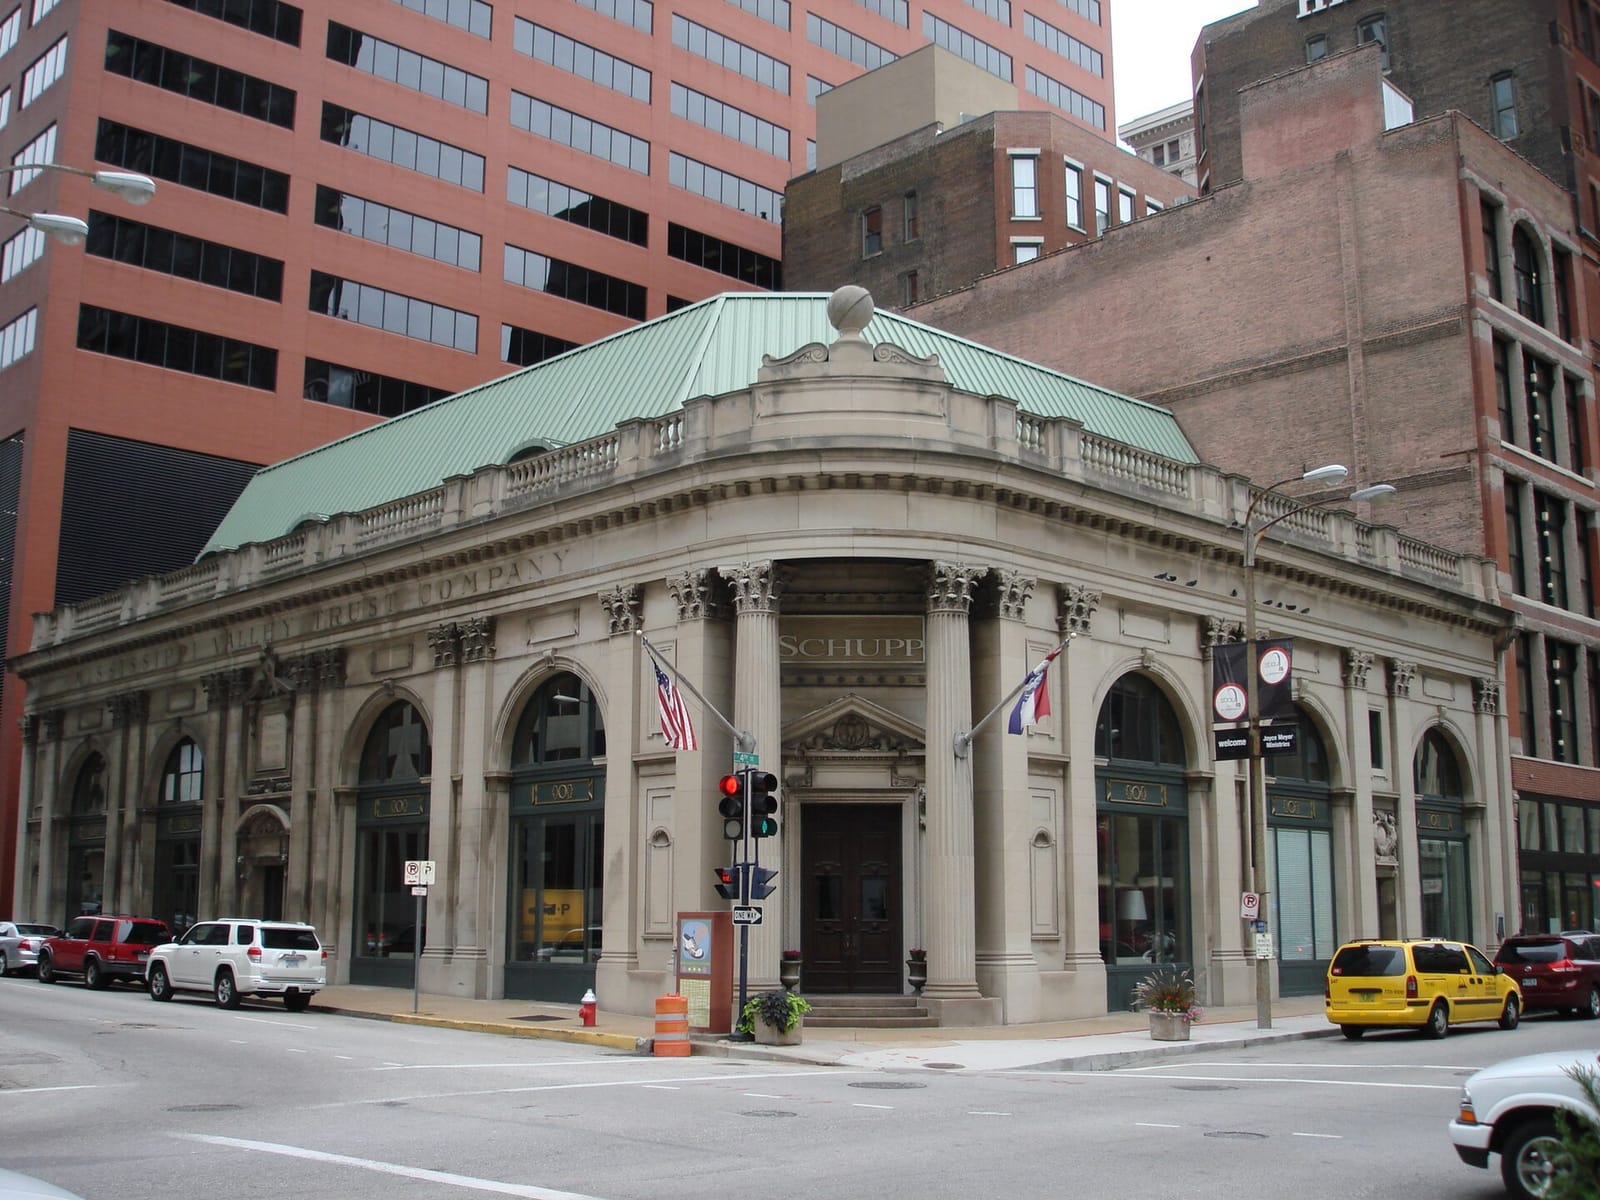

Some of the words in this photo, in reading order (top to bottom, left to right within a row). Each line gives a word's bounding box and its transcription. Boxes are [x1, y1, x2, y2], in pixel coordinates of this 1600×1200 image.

[213, 616, 295, 652] VALLEY
[312, 592, 398, 630] TRUST
[418, 549, 571, 606] COMPANY
[779, 634, 924, 657] SCHUPP
[1218, 739, 1246, 748] welcome
[735, 911, 745, 919] ONE
